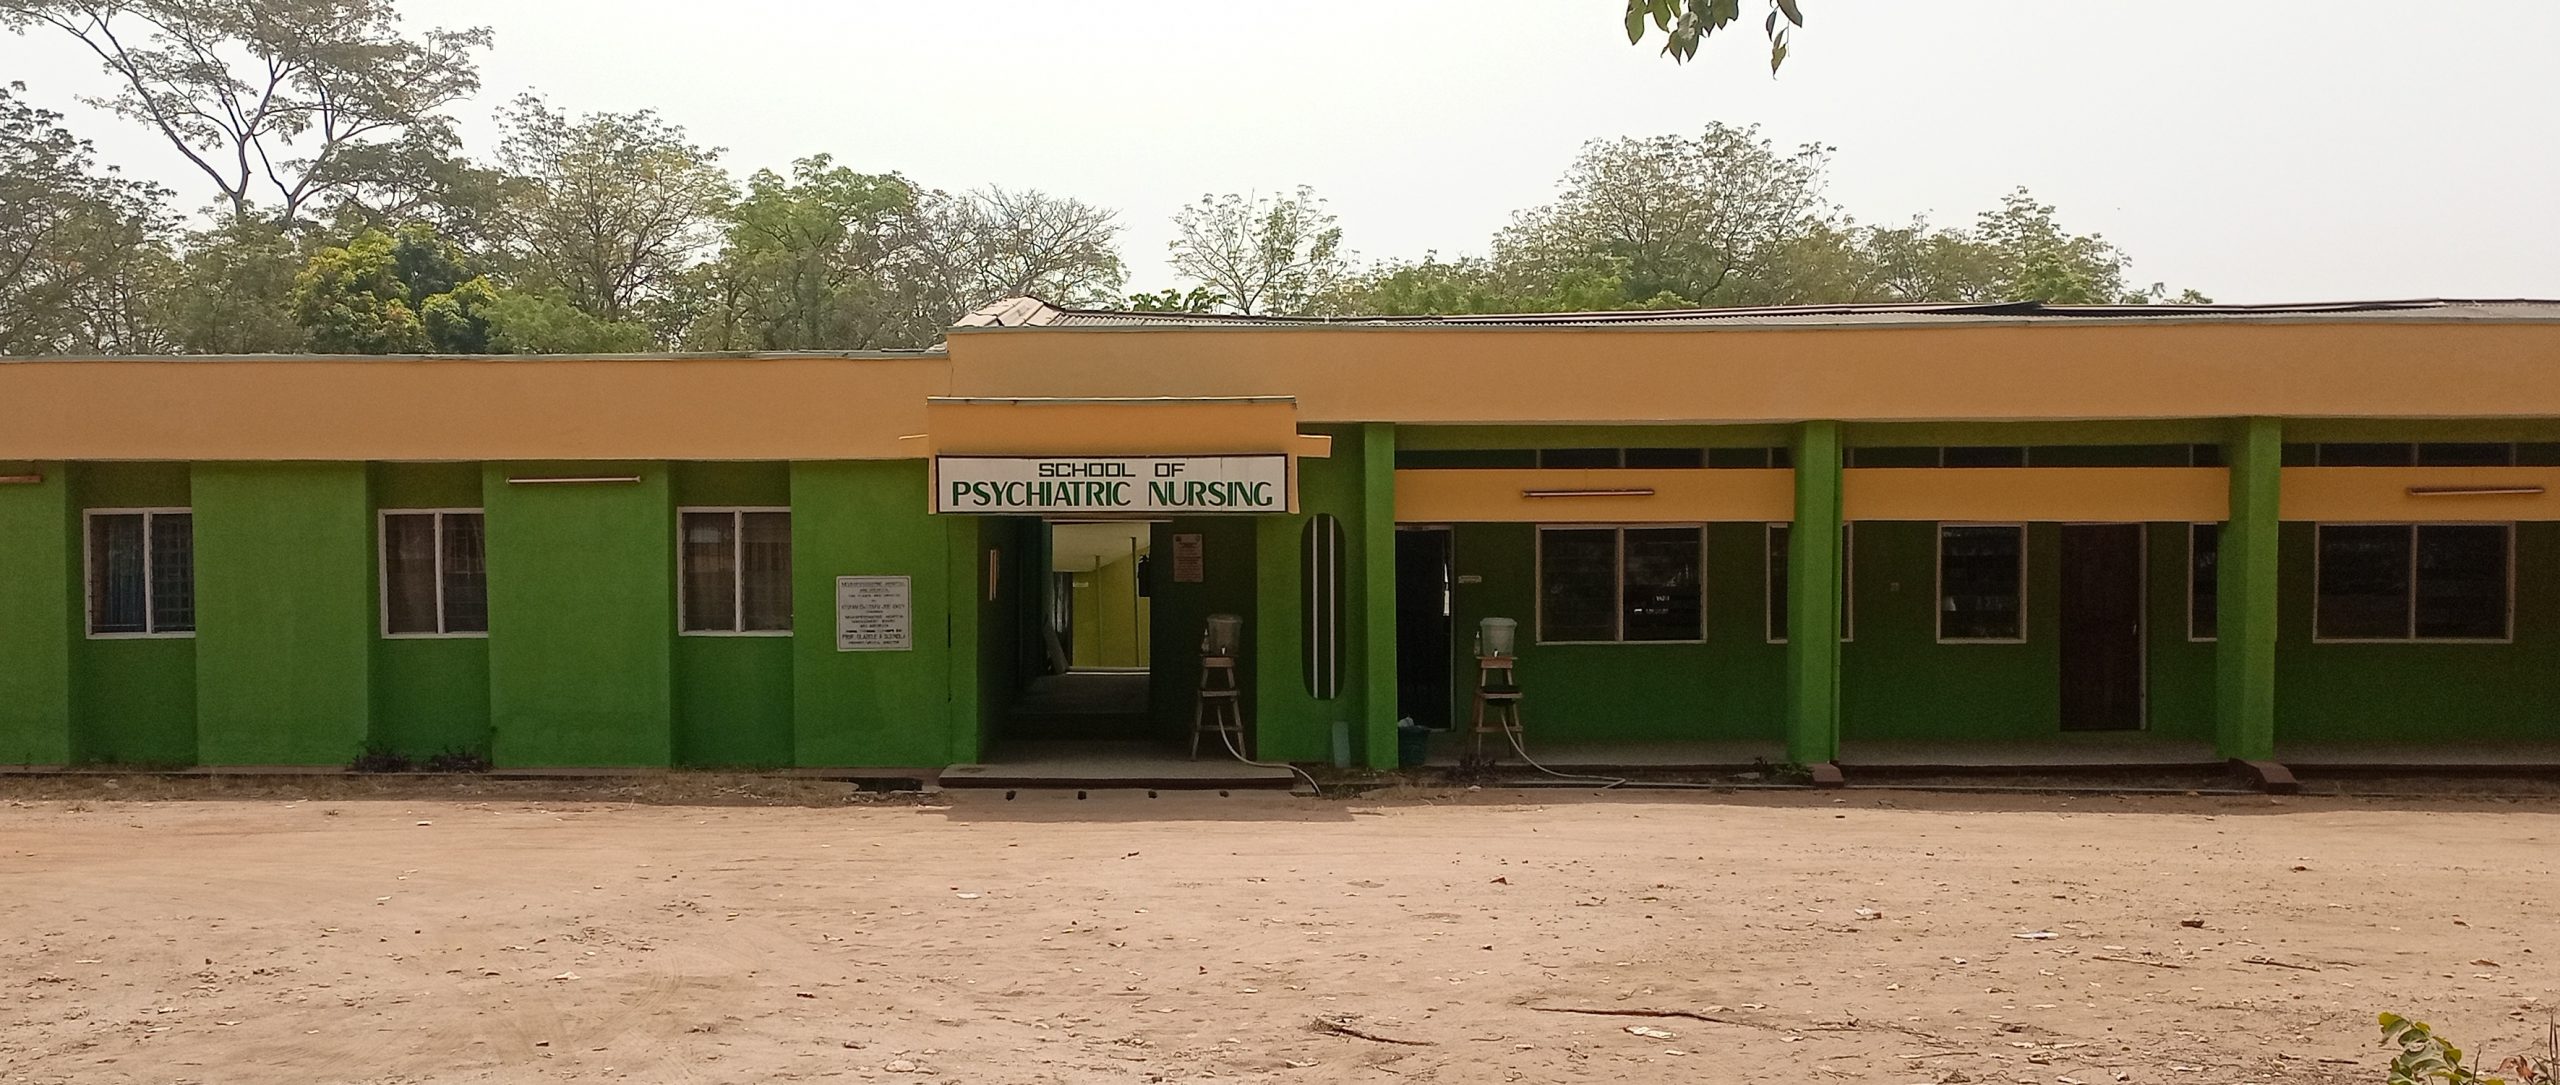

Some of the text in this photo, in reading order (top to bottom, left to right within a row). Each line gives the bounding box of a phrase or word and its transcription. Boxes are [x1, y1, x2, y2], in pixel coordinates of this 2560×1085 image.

[1039, 463, 1186, 478] SCHOOL OF
[952, 481, 1273, 507] PSYCHIATRIC NURSING
